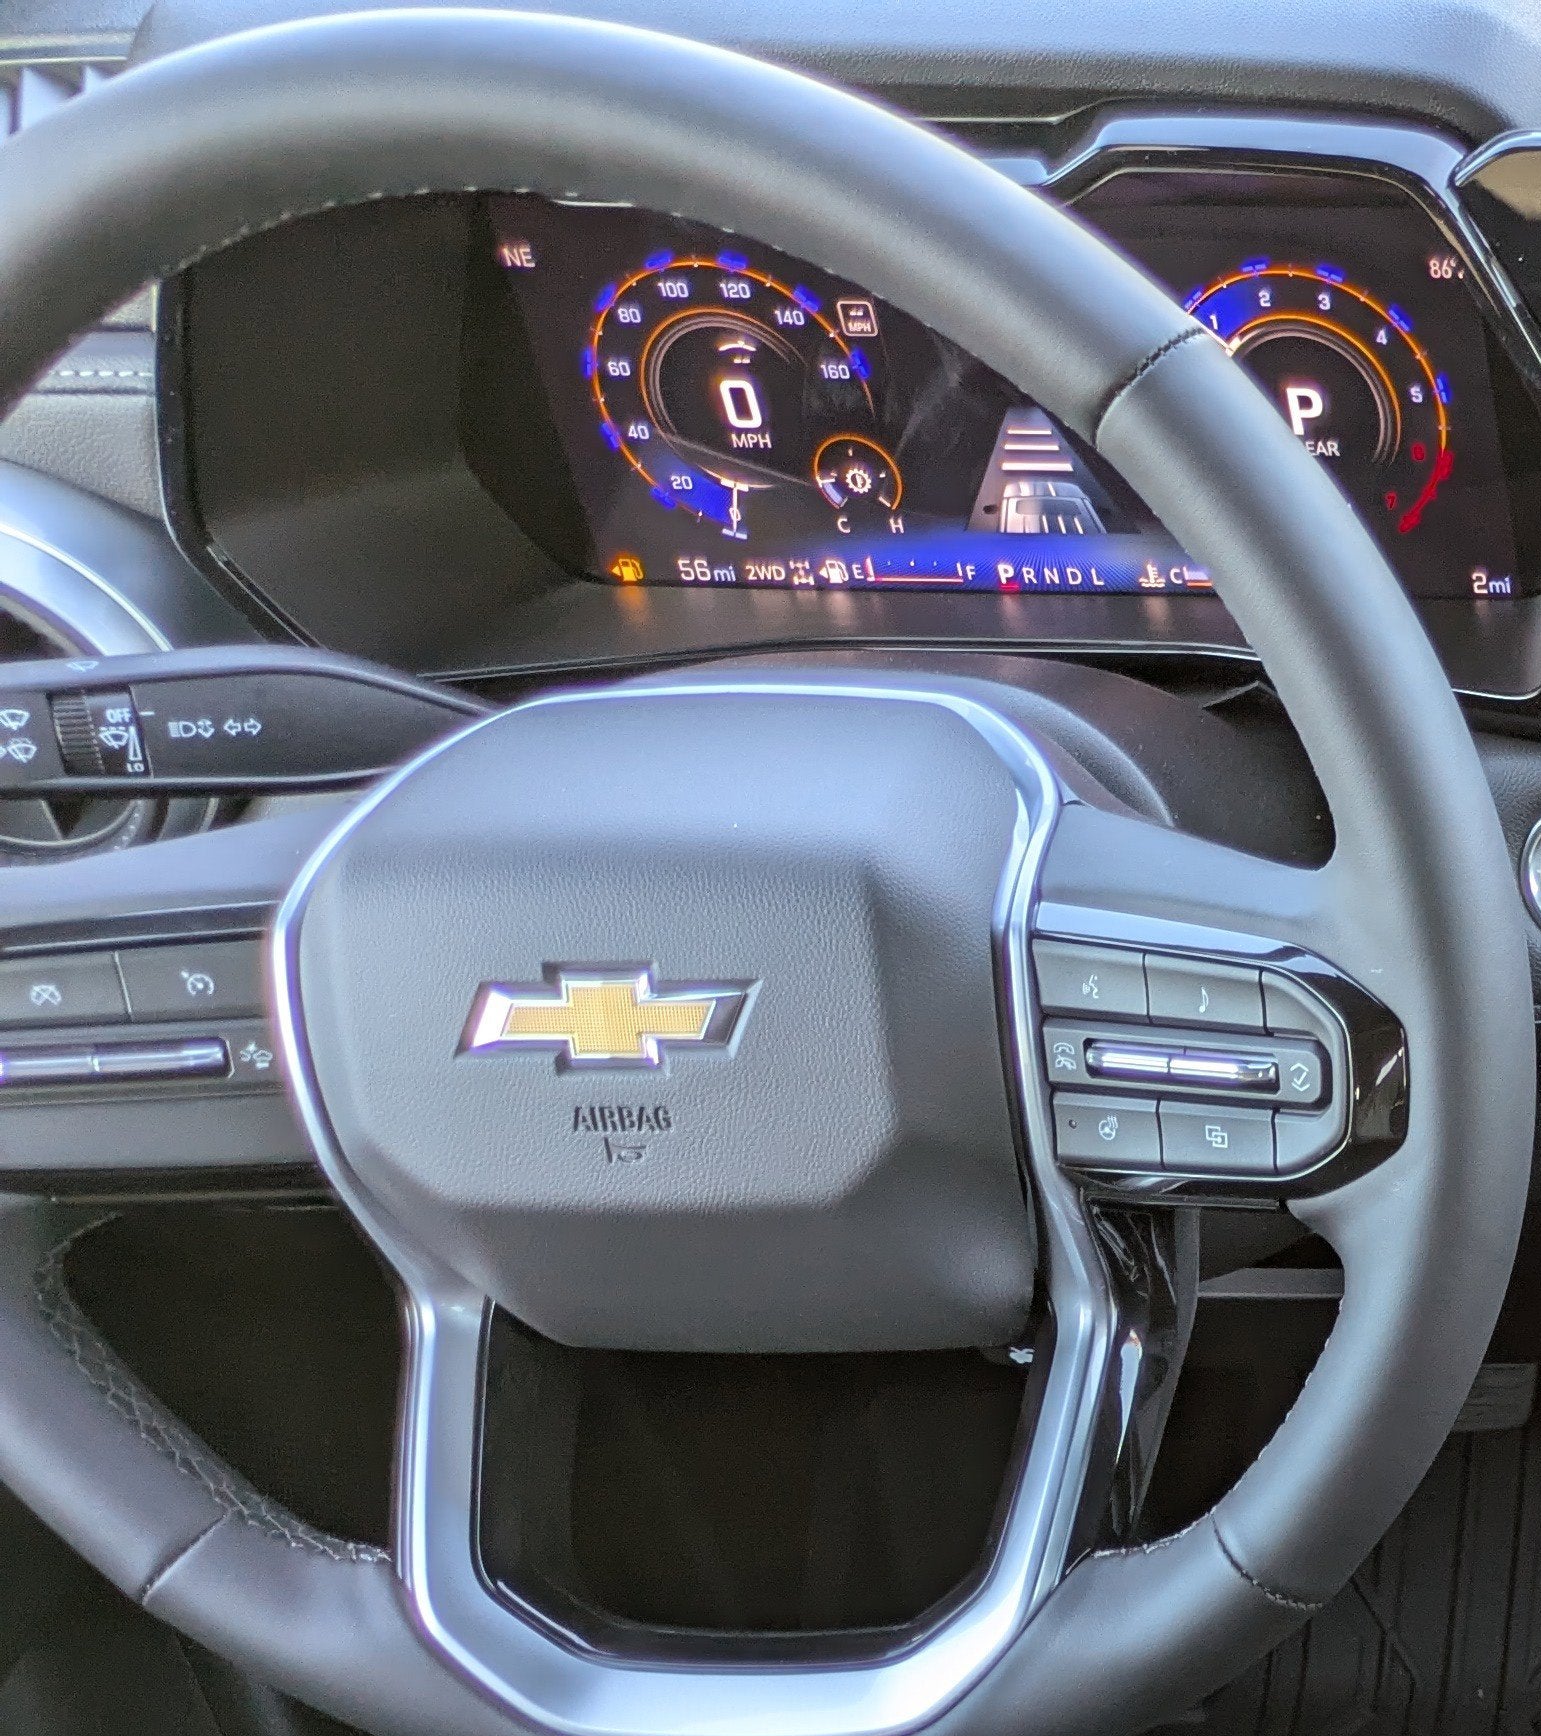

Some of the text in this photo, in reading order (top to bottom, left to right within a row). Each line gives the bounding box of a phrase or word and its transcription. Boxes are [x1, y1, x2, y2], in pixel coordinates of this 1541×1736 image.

[502, 246, 535, 269] NE
[658, 281, 689, 298] 100
[720, 282, 751, 299] 120
[1258, 291, 1272, 307] 2
[1317, 293, 1331, 310] 3
[617, 307, 642, 323] 80
[774, 309, 805, 326] 140
[1209, 313, 1219, 330] 1
[847, 321, 872, 333] MPH
[1375, 328, 1389, 345] 4
[607, 361, 631, 377] 60
[820, 363, 851, 379] 160
[1409, 385, 1424, 403] 5
[719, 379, 762, 429] 0
[1286, 387, 1324, 436] P
[628, 425, 650, 440] 40
[731, 433, 773, 450] MPH
[1303, 441, 1341, 458] EAR
[670, 475, 693, 491] 20
[836, 518, 851, 533] C
[890, 517, 905, 534] H
[745, 564, 786, 581] 2WD
[852, 564, 864, 580] E
[997, 564, 1105, 586] P R N D L
[106, 708, 132, 723] OFF
[573, 1105, 672, 1132] AIRBAG
